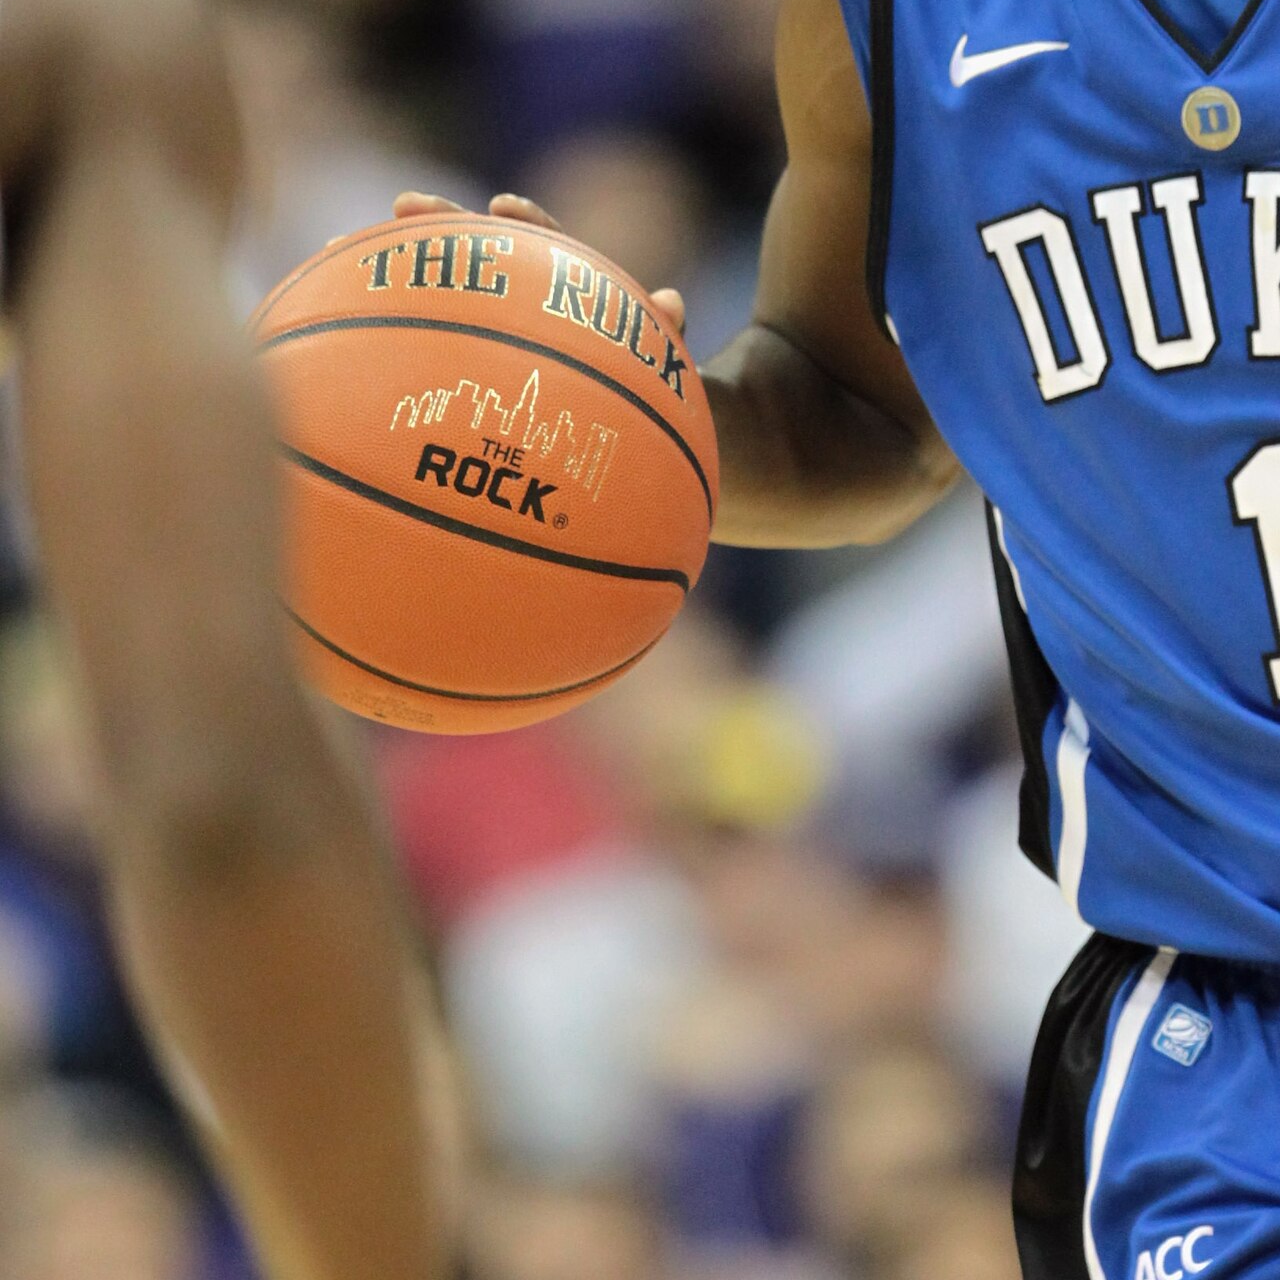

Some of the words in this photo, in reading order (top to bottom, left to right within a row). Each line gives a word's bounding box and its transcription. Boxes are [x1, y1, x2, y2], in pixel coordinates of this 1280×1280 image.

[359, 233, 514, 298] THE
[543, 246, 689, 401] ROCK
[481, 438, 525, 468] THE
